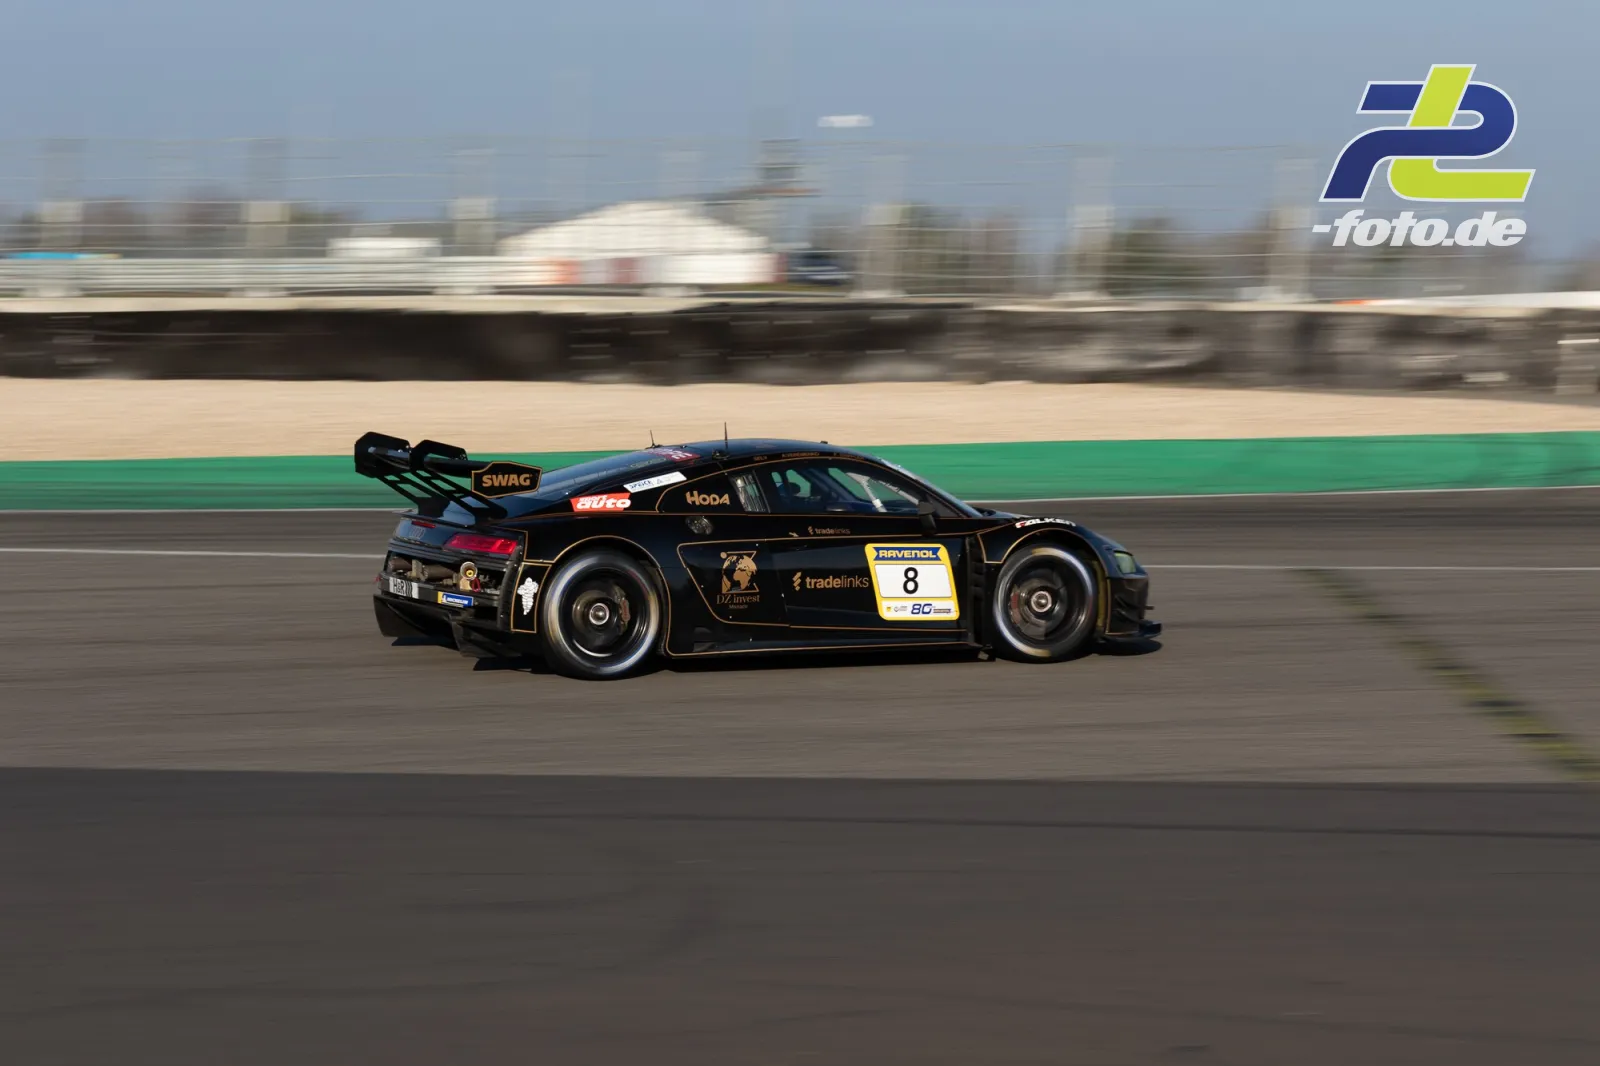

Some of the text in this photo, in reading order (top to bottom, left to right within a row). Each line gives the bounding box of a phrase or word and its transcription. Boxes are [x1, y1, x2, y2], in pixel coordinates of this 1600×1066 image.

[482, 474, 530, 487] SWAG
[576, 498, 631, 509] auto
[686, 491, 730, 506] HODA
[879, 550, 936, 558] RAVENOL
[805, 575, 869, 589] tradelinks
[903, 567, 919, 594] 8
[716, 594, 760, 605] DZ invest
